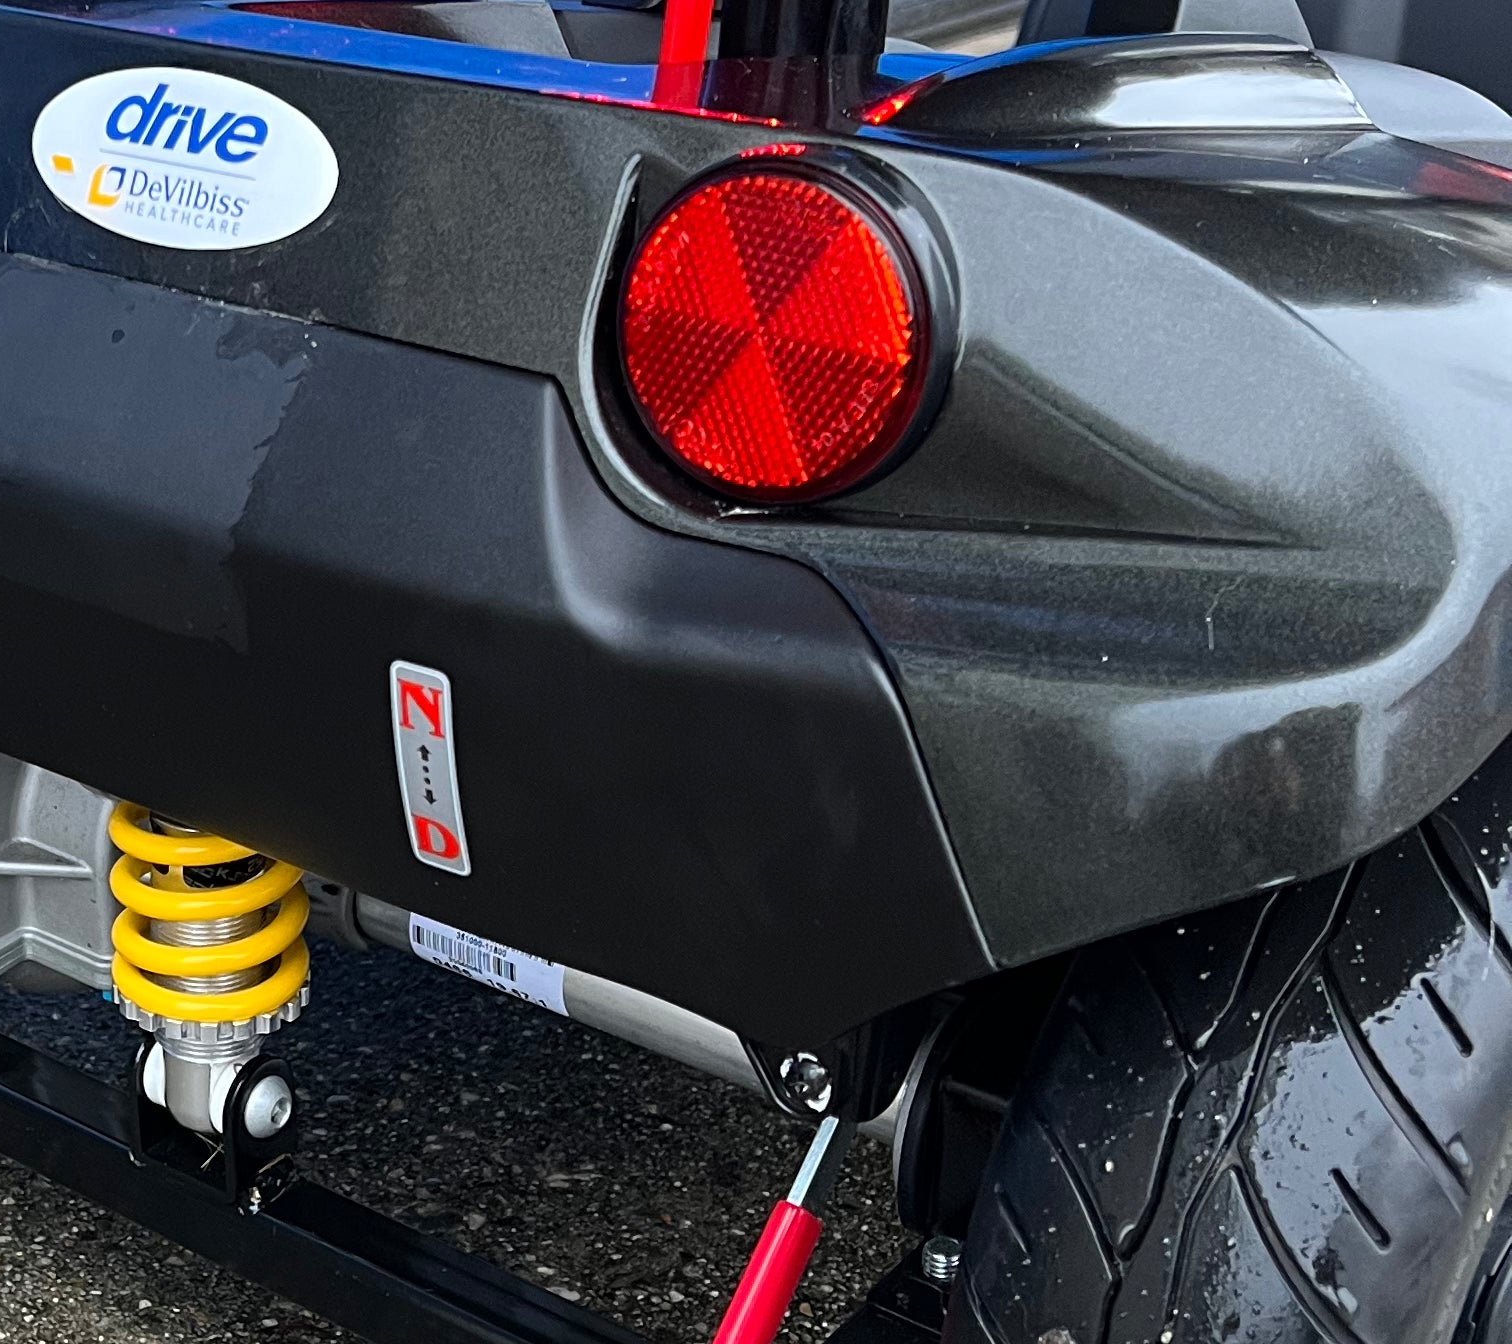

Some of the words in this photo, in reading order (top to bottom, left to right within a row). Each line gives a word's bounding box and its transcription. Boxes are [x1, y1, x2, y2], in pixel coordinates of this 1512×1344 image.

[105, 83, 268, 163] drive
[129, 170, 246, 218] DeVilbiss
[125, 200, 240, 237] HEALTHCARE
[397, 678, 445, 739] N
[412, 814, 461, 860] D
